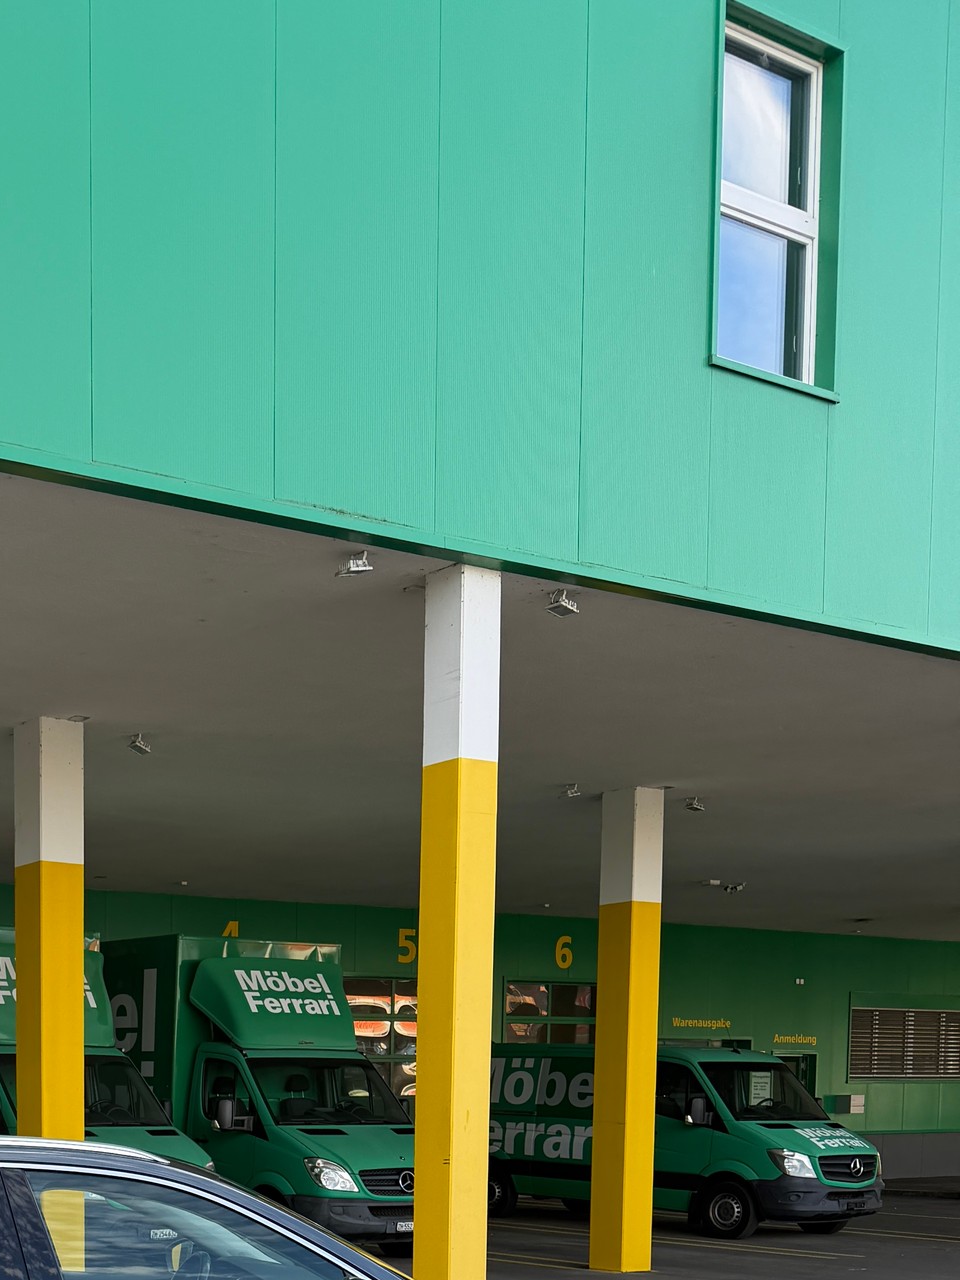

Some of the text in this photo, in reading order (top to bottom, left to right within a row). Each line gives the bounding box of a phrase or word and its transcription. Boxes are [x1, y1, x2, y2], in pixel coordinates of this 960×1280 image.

[398, 928, 417, 964] 5
[555, 935, 573, 969] 6
[234, 969, 331, 994] Möbel
[243, 991, 341, 1016] Ferrari
[672, 1017, 731, 1030] Warenausgabe
[773, 1033, 817, 1046] Anmeldung
[809, 1137, 870, 1150] Ferrari
